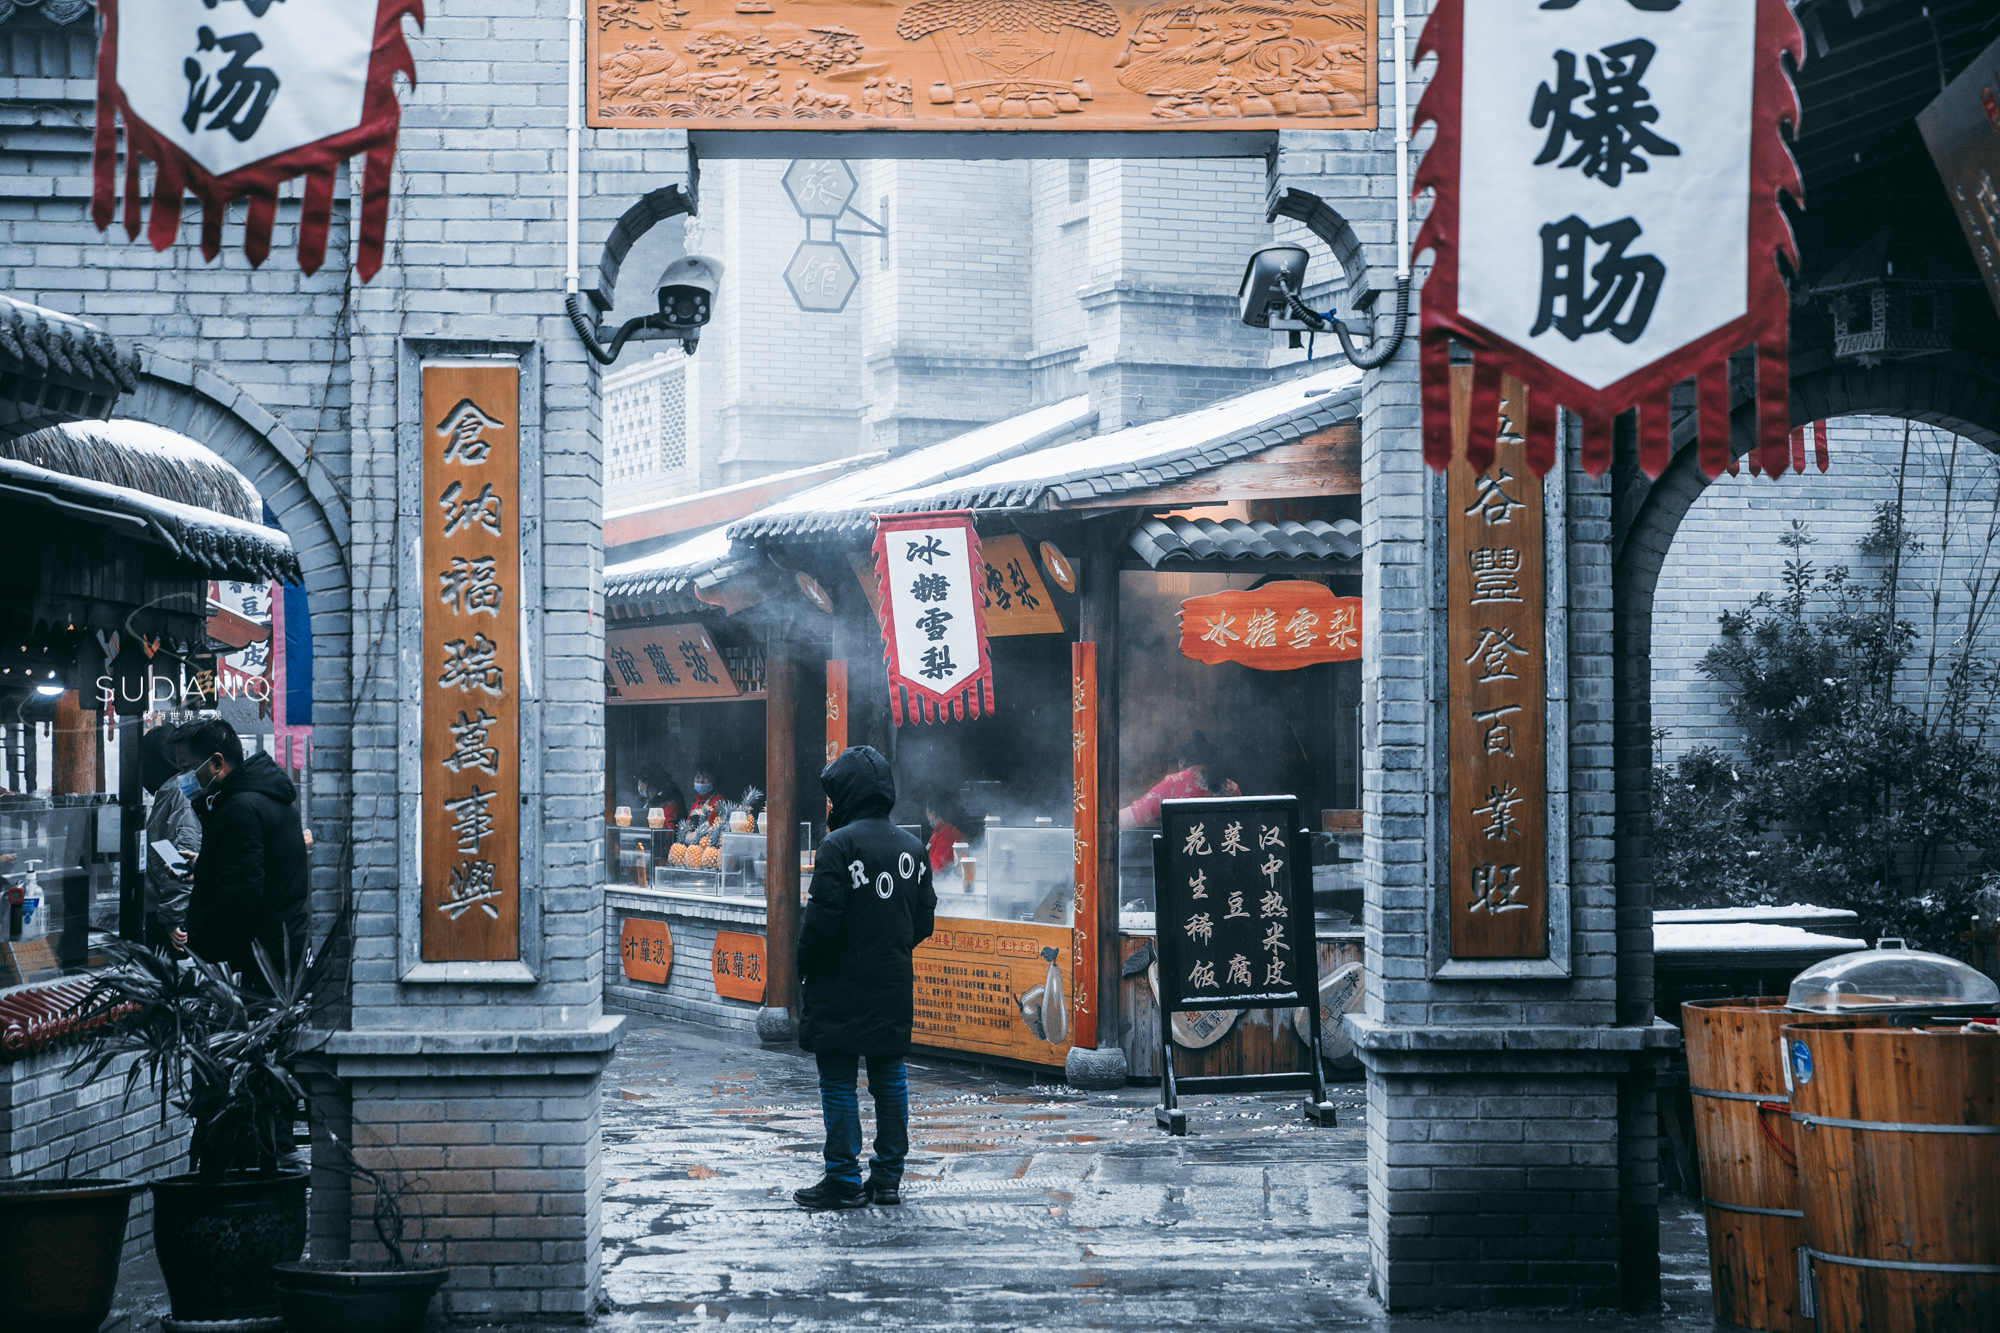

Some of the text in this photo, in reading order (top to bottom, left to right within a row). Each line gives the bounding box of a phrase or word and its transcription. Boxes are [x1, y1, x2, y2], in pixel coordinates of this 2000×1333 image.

[182, 0, 287, 142] 汤
[1530, 0, 1681, 344] 爆肠
[905, 535, 957, 680] 冰糖雪梨
[984, 557, 1040, 611] 雪梨
[1200, 604, 1358, 651] 冰糖雪梨
[1182, 822, 1220, 989] 花生稀饭
[1221, 821, 1252, 988] 菜豆腐
[1258, 824, 1293, 986] 汉中热米皮
